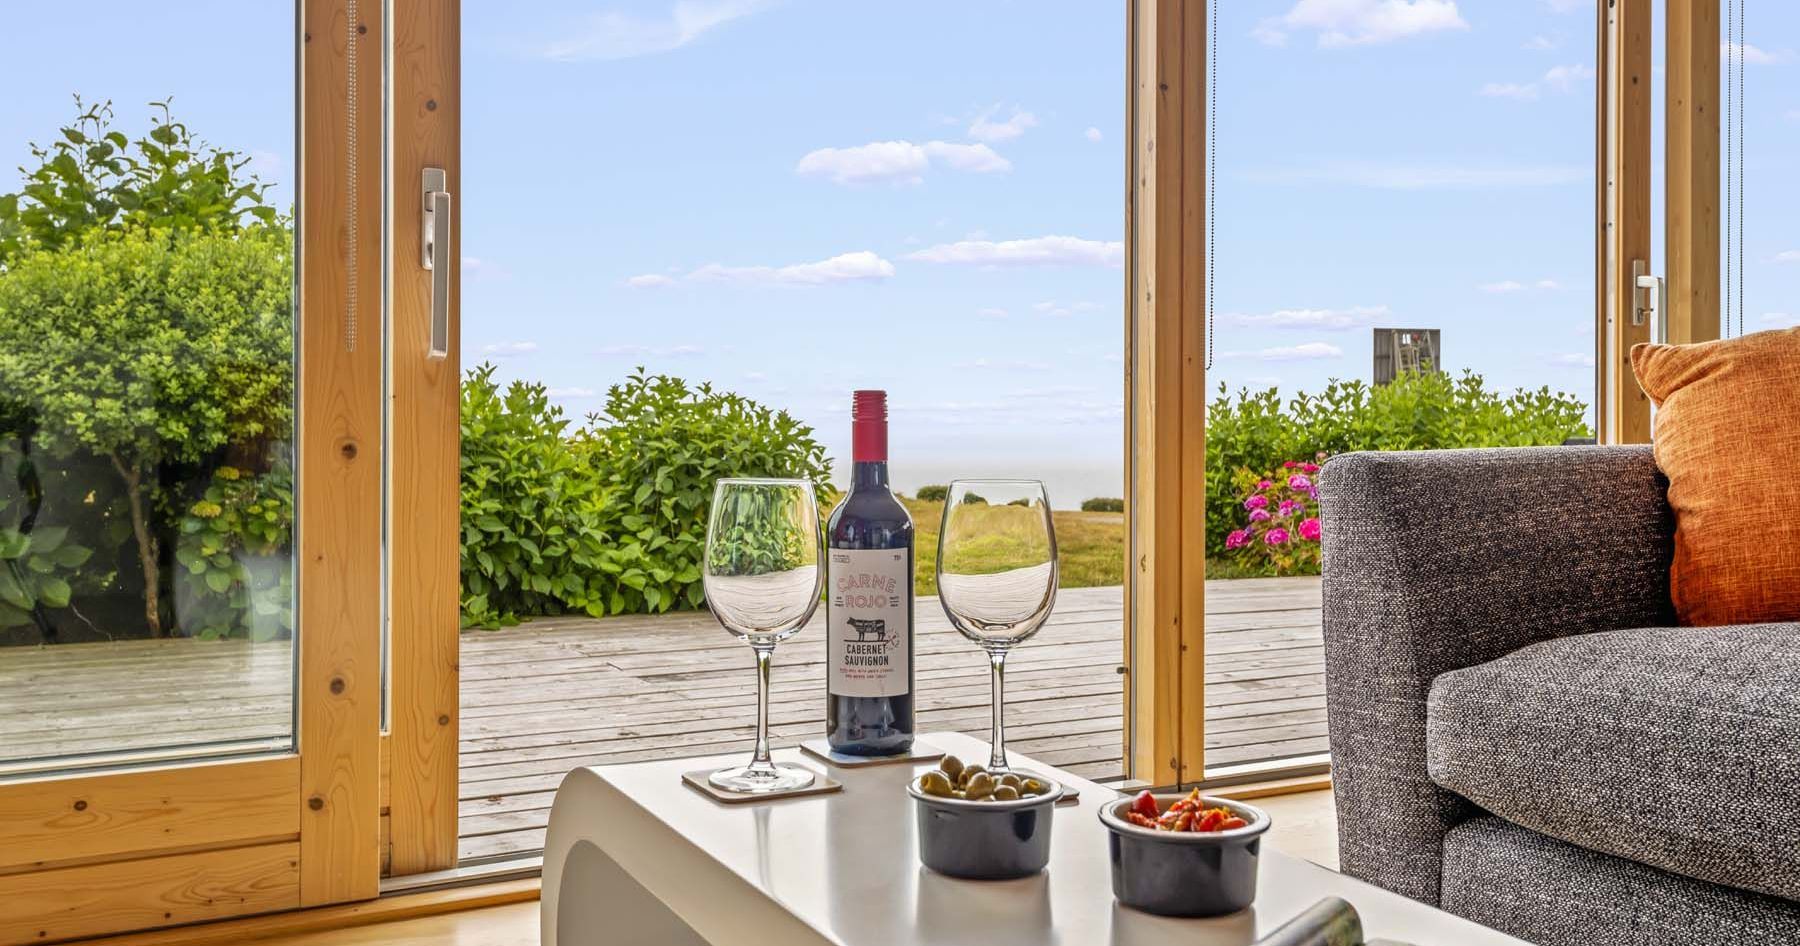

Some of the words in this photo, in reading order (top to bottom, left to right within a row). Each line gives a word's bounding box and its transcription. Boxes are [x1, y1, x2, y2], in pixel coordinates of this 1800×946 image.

[837, 574, 897, 594] CARNE
[845, 595, 888, 608] ROJO
[846, 644, 887, 655] CABERNET
[845, 655, 889, 666] SAUVIGNON
